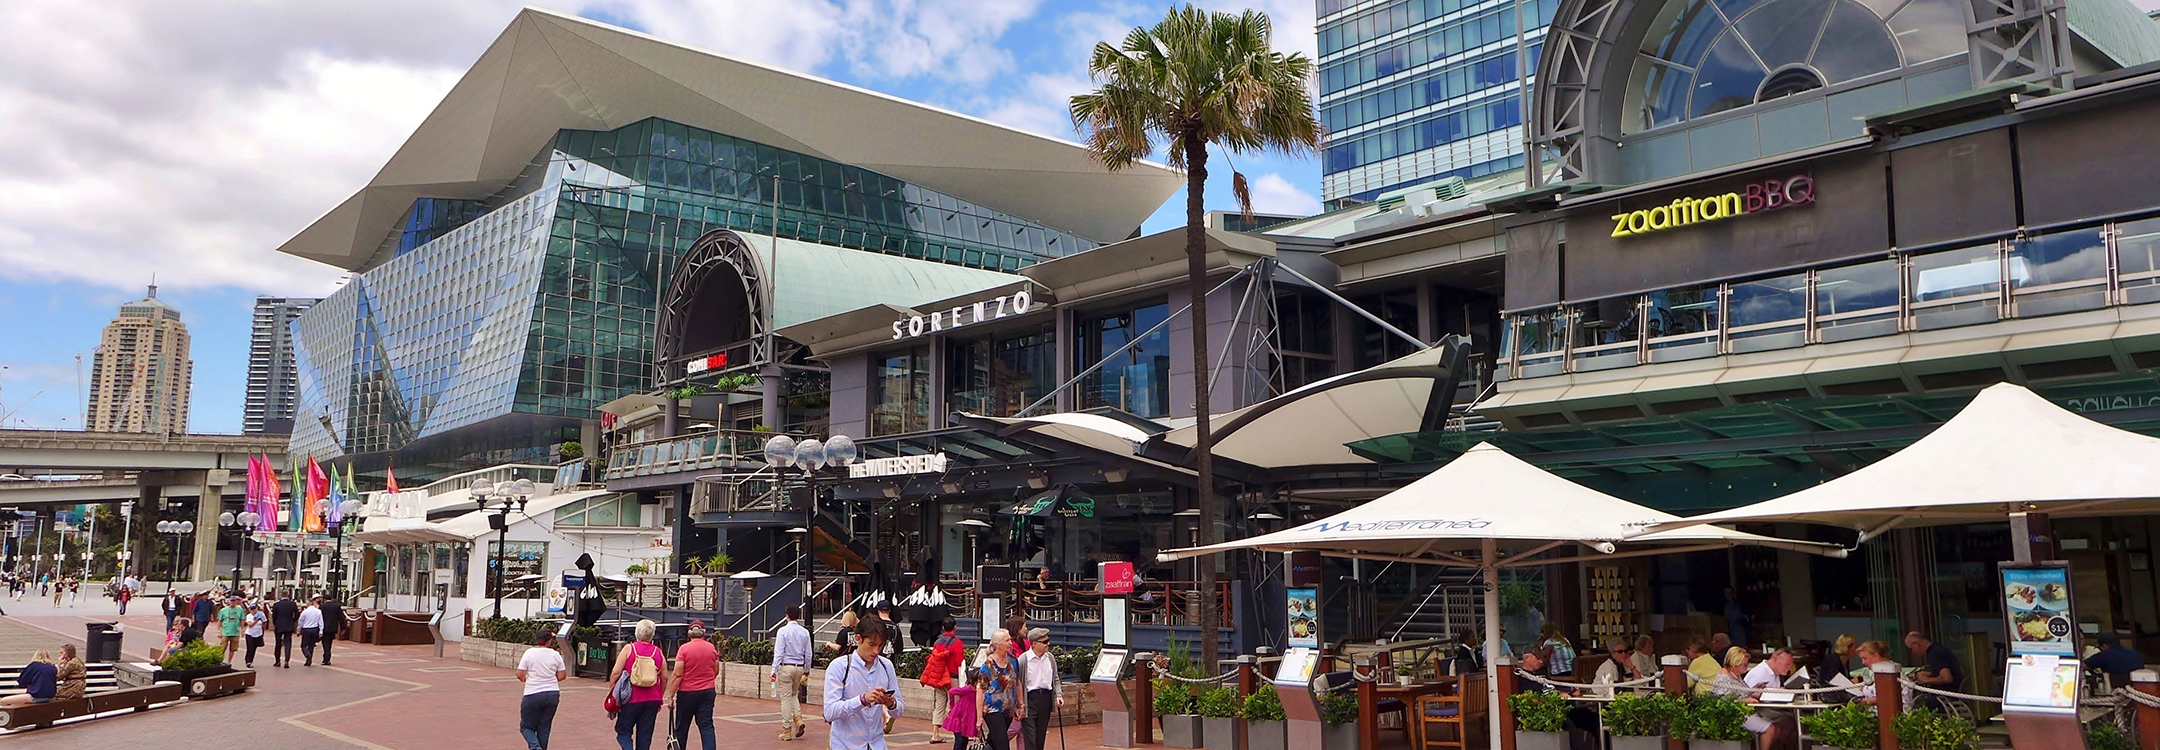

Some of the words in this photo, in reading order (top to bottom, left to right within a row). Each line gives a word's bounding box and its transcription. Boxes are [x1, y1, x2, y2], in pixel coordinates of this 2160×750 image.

[1611, 192, 1743, 238] zaaffran
[1746, 174, 1815, 212] BBQ
[892, 291, 1031, 340] SORENZO
[1105, 579, 1132, 589] zaaffran
[2051, 624, 2067, 632] $13
